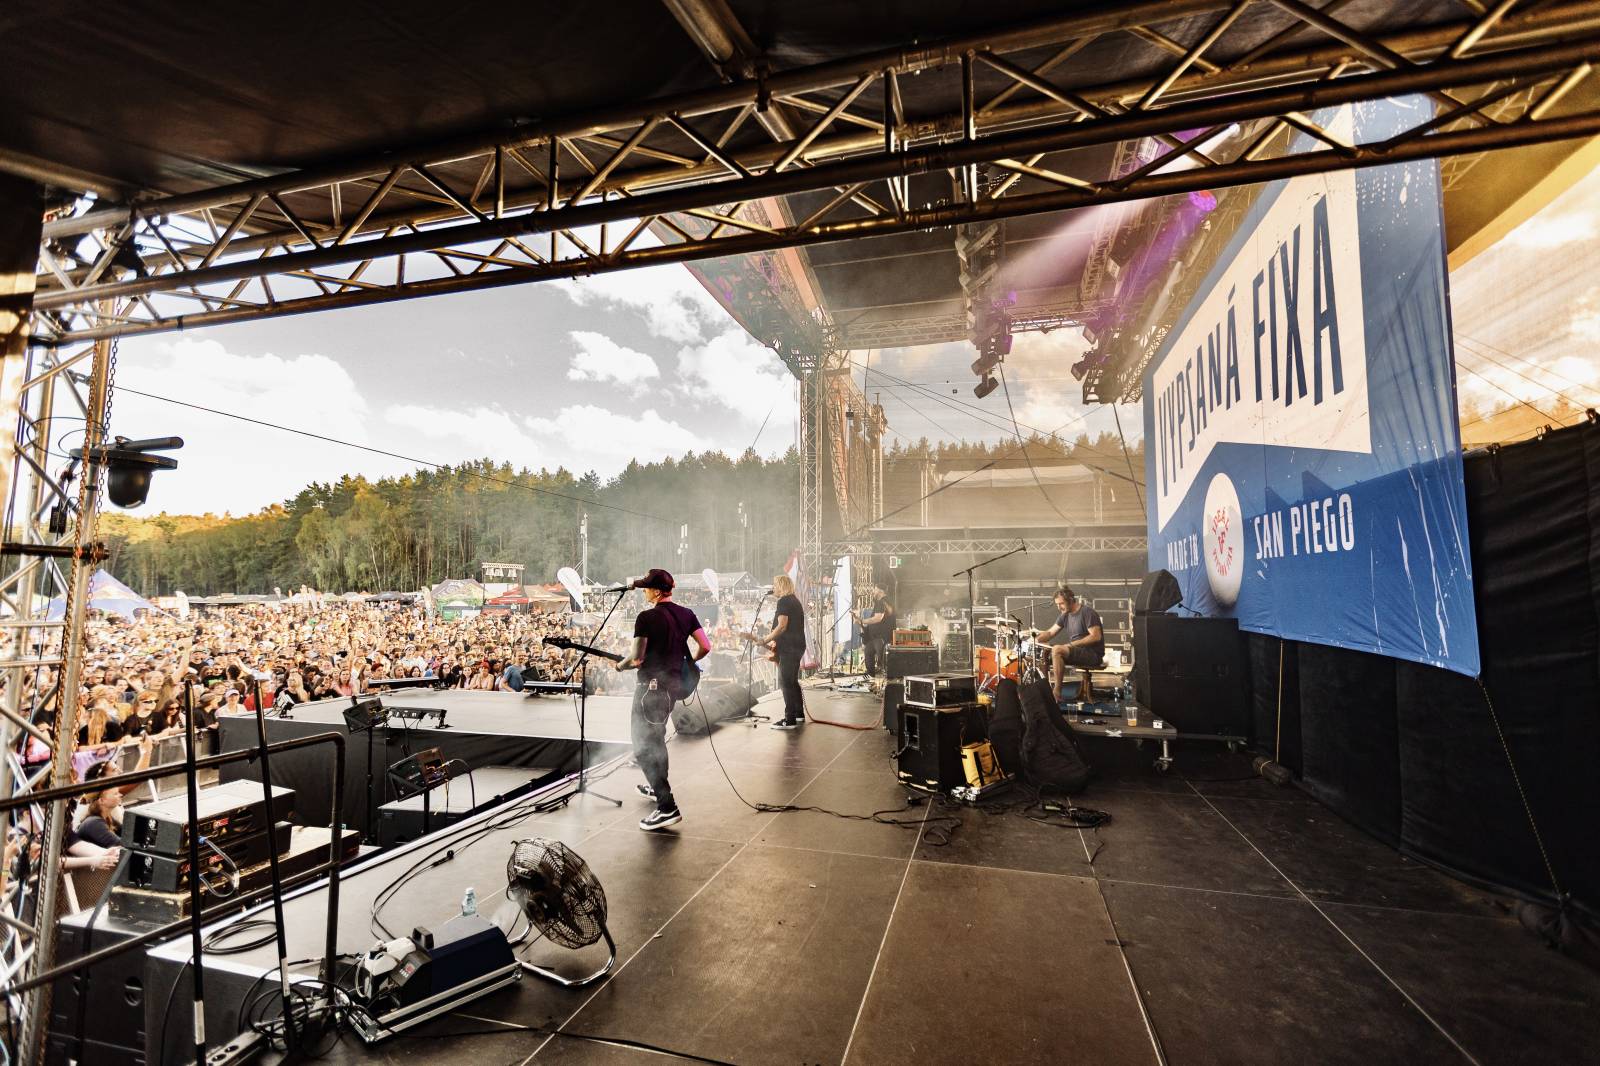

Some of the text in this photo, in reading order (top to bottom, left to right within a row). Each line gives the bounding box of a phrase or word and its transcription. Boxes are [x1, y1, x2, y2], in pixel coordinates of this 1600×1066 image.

[1159, 194, 1344, 497] VYPSANÁ FIXA
[1167, 537, 1188, 571] MADE
[1189, 533, 1199, 567] IN
[1254, 510, 1284, 560] SAN
[1290, 493, 1354, 555] PIEGO
